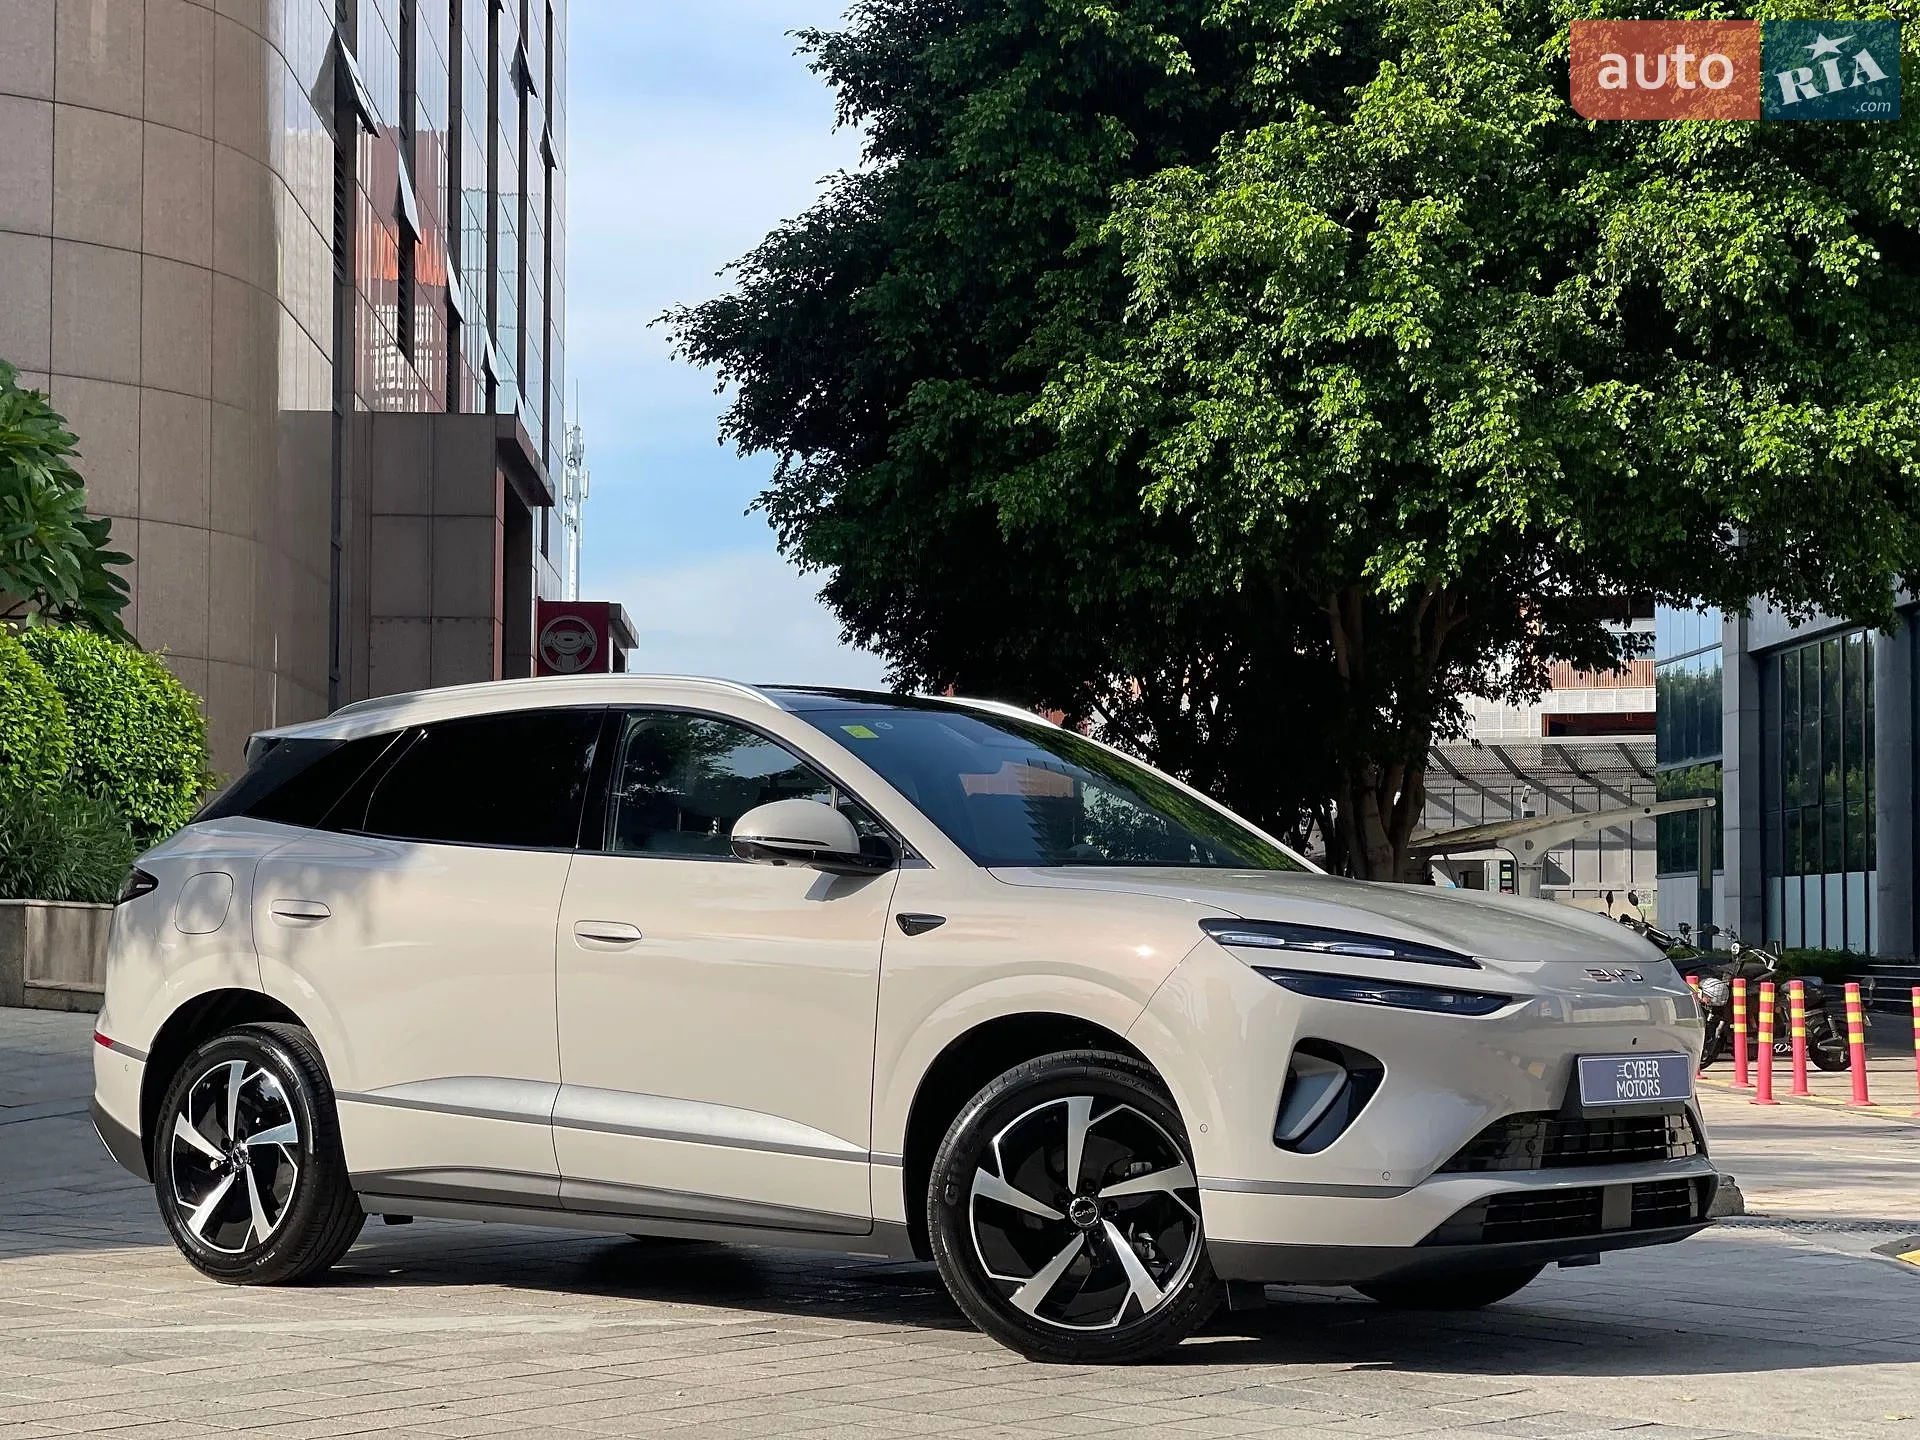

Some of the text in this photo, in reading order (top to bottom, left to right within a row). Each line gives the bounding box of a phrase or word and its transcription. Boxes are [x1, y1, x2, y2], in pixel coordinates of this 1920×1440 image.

[1584, 968, 1644, 983] BYD
[1623, 1060, 1660, 1079] CYBER
[1616, 1079, 1661, 1098] MOTORS
